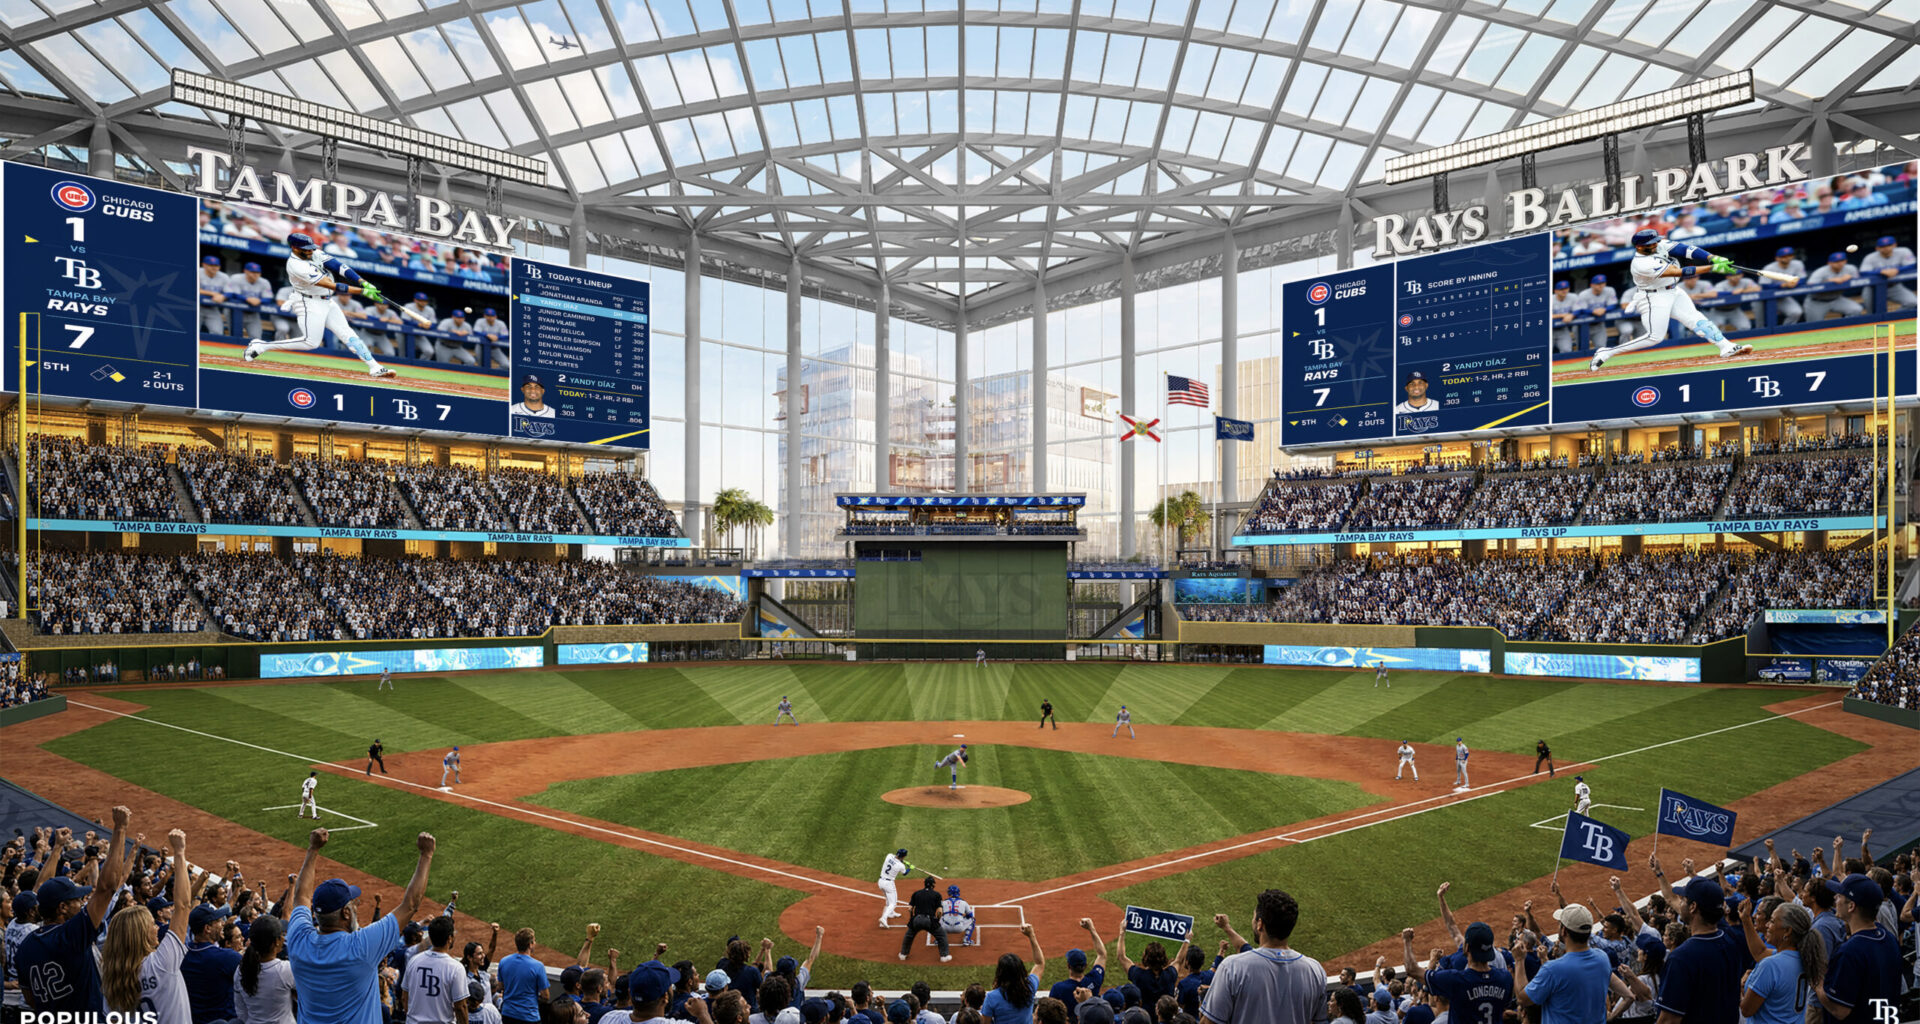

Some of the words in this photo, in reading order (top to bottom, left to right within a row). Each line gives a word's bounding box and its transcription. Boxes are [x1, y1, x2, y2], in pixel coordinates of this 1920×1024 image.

[102, 195, 154, 210] CHICAGO
[187, 145, 404, 229] TAMPA
[414, 194, 519, 250] BAY
[1372, 205, 1489, 258] RAYS
[1509, 143, 1811, 233] BALLPARK
[102, 205, 154, 222] CUBS
[65, 216, 85, 242] 1
[70, 245, 86, 254] VS
[55, 256, 102, 290] TB
[523, 263, 542, 280] TB
[538, 283, 560, 291] PLAYER
[548, 272, 583, 284] TODAY'S
[584, 278, 613, 290] LINEUP
[1334, 279, 1366, 290] CHICAGO
[1427, 279, 1454, 289] SCORE
[1456, 276, 1467, 284] BY
[1468, 271, 1498, 283] INNING
[1334, 286, 1366, 300] CUBS
[1404, 280, 1423, 296] TB
[46, 288, 91, 302] TAMPA
[93, 295, 116, 305] BAY
[540, 291, 575, 301] JONATHAN
[47, 299, 108, 316] RAYS
[540, 300, 562, 308] YANDY
[538, 308, 562, 316] JUNIOR
[1314, 307, 1326, 326] 1
[64, 324, 95, 349] 7
[538, 325, 560, 333] JONNY
[538, 333, 572, 342] CHANDLER
[538, 350, 561, 358] TAYLOR
[1308, 338, 1336, 361] TB
[43, 362, 70, 372] 5TH
[1304, 363, 1328, 372] TAMPA
[1329, 361, 1343, 369] BAY
[1442, 363, 1451, 372] 2
[1454, 361, 1484, 370] YANDY
[1485, 358, 1507, 367] DÍAZ
[1526, 353, 1540, 361] DH
[153, 371, 171, 380] 2-1
[558, 374, 566, 383] 2
[570, 377, 596, 387] YANDY
[598, 380, 616, 389] DÍAZ
[1304, 369, 1338, 382] RAYS
[1443, 377, 1474, 385] TODAY:
[1475, 374, 1490, 382] 1-2,
[1805, 371, 1827, 392] 7
[143, 380, 151, 388] 2
[153, 381, 184, 391] OUTS
[1748, 375, 1781, 399] TB
[558, 390, 587, 399] TODAY:
[1313, 388, 1331, 407] 7
[1679, 384, 1690, 403] 1
[333, 394, 344, 411] 1
[392, 398, 419, 421] TB
[435, 404, 452, 421] 7
[1364, 411, 1377, 419] 2-1
[1365, 418, 1385, 427] OUTS
[113, 522, 152, 532] TAMPA
[155, 523, 176, 533] BAY
[179, 523, 207, 534] RAYS
[319, 528, 351, 538] TAMPA
[354, 529, 372, 539] BAY
[373, 529, 398, 539] RAYS
[1521, 528, 1549, 538] RAYS
[1552, 527, 1567, 537] UP
[1707, 522, 1751, 533] TAMPA
[1754, 521, 1781, 531] BAY
[1784, 519, 1819, 530] RAYS
[487, 533, 515, 542] TAMPA
[516, 534, 532, 543] BAY
[533, 534, 553, 543] RAYS
[618, 537, 643, 546] TAMPA
[644, 538, 659, 546] BAY
[660, 538, 678, 547] RAYS
[1334, 533, 1366, 542] TAMPA
[1368, 532, 1387, 541] BAY
[1389, 532, 1414, 541] RAYS
[1665, 797, 1729, 836] RAYS
[1580, 821, 1614, 862] TB
[885, 865, 892, 875] 2
[1128, 911, 1144, 930] TB
[1149, 915, 1188, 935] RAYS
[30, 961, 74, 1003] 42
[417, 967, 441, 998] TB
[1467, 984, 1506, 1001] LONGORIA
[1478, 1002, 1493, 1024] 3
